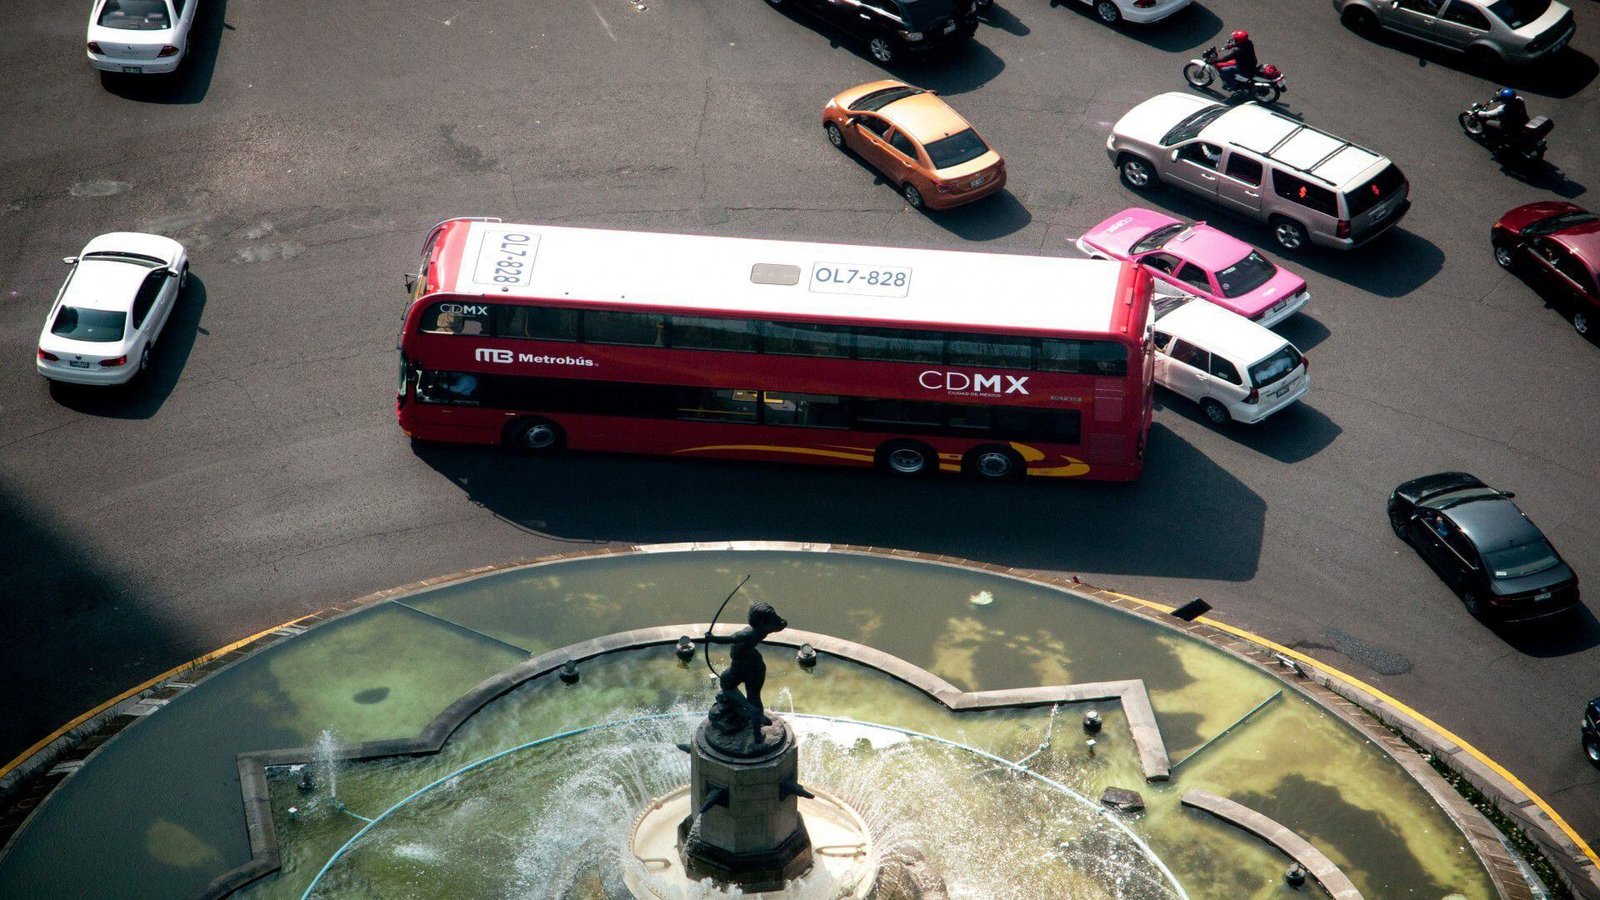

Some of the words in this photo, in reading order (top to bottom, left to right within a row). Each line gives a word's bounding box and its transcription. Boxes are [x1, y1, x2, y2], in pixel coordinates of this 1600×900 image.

[493, 234, 530, 283] OL7-828
[815, 267, 906, 287] OL7-828
[440, 303, 488, 316] CDMX
[519, 353, 594, 367] Metrobús
[918, 370, 1030, 395] CDMX
